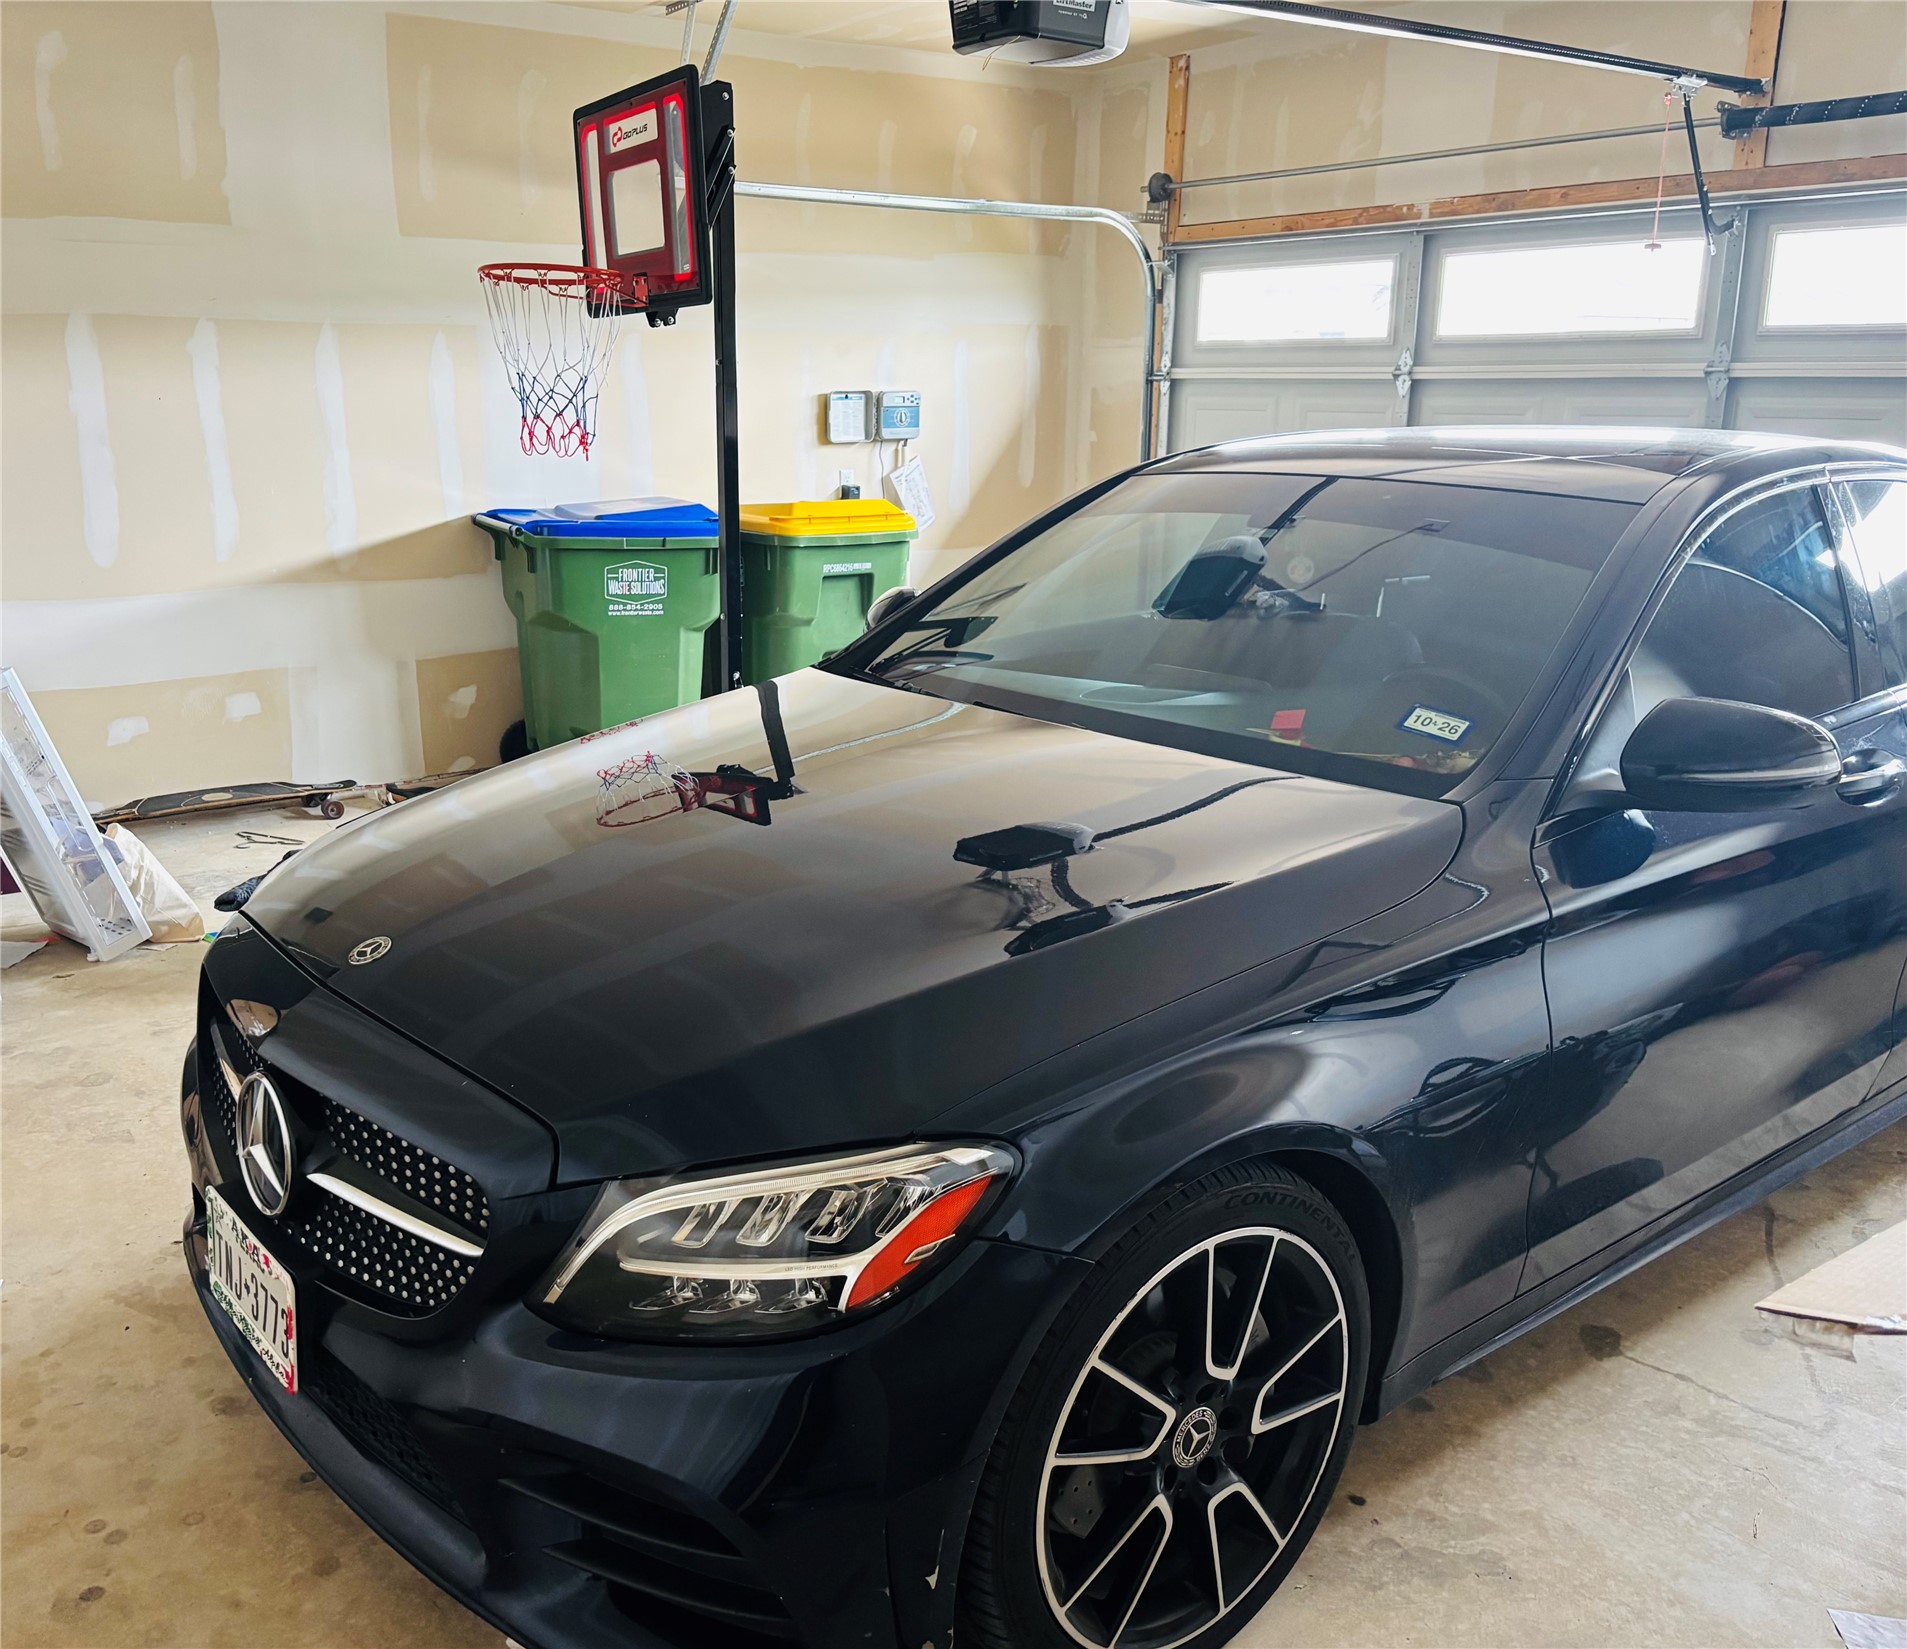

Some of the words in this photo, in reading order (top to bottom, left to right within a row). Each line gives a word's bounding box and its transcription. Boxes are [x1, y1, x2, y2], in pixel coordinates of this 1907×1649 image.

[618, 568, 655, 582] FRONTIER
[608, 579, 630, 595] WASTE
[630, 579, 665, 595] SOLUTIONS
[1413, 714, 1433, 727] 10
[1437, 721, 1461, 735] 26
[1223, 1191, 1356, 1263] CONTINENTAL
[1176, 1410, 1203, 1442] MERCEDES
